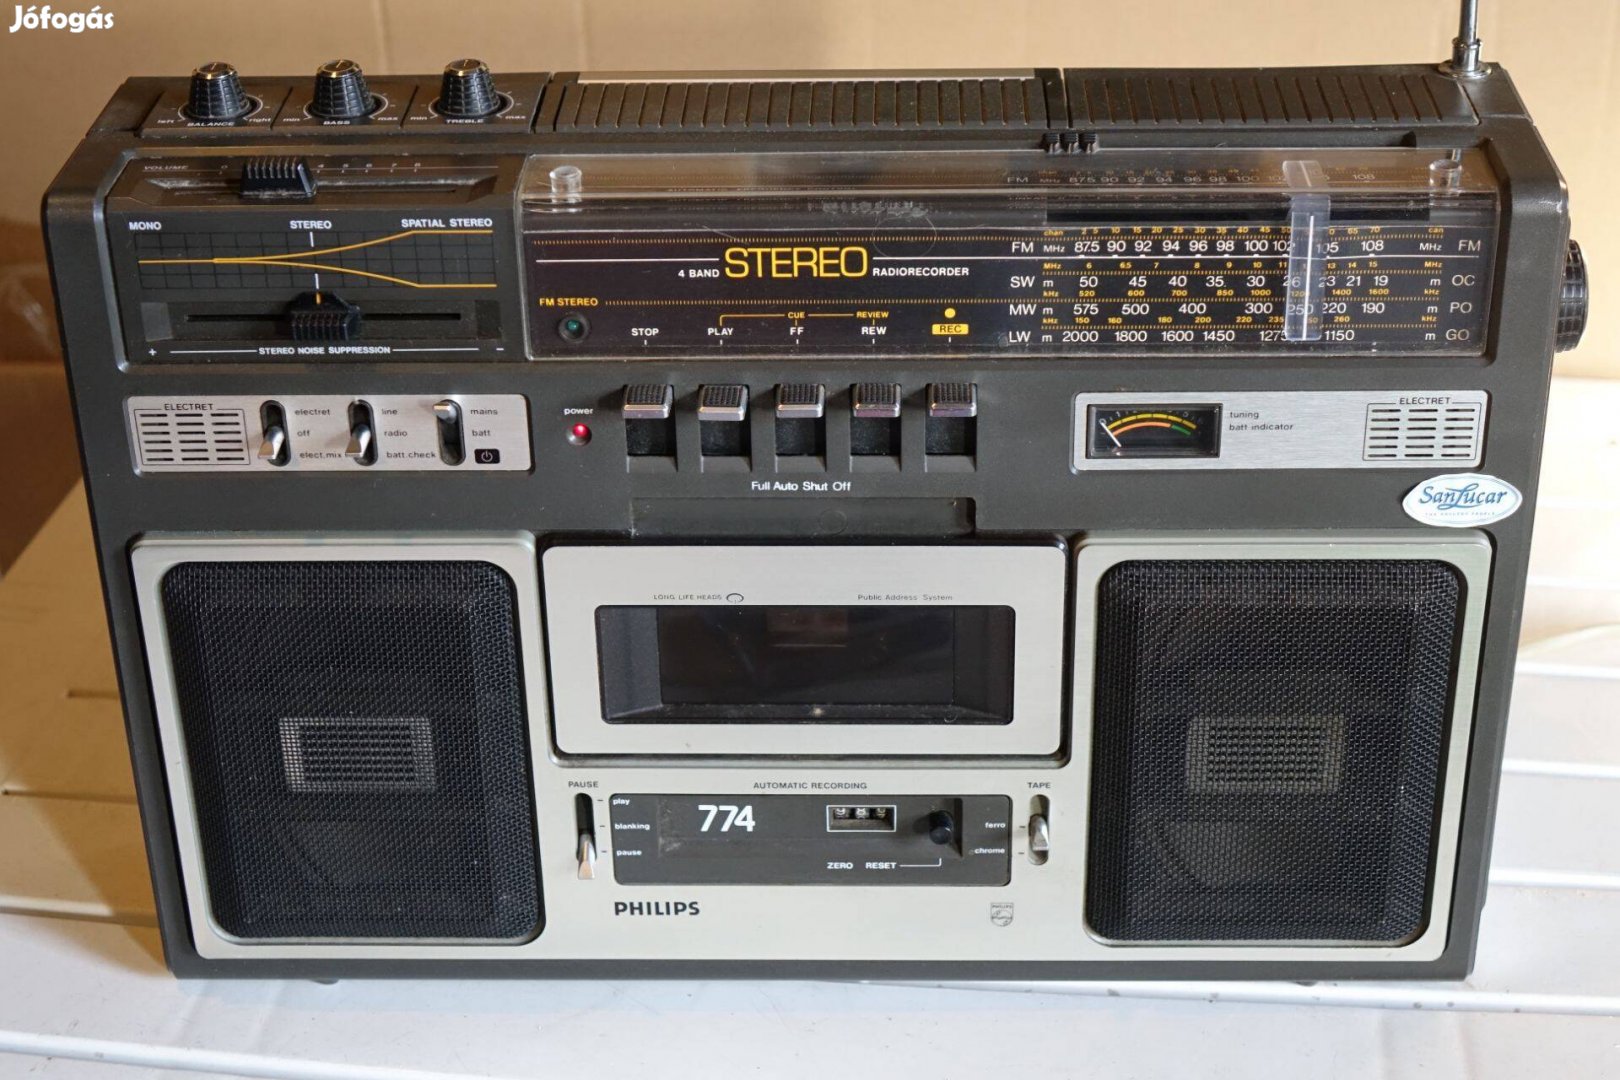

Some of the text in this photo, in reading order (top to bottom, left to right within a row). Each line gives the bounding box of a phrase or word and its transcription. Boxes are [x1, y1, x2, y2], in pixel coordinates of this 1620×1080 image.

[128, 221, 162, 230] MONO
[289, 220, 332, 229] STEREO
[401, 218, 493, 228] SPATIAL STEREO
[1012, 241, 1034, 253] FM
[1044, 245, 1065, 253] MHz
[1074, 240, 1100, 253] 87.5
[1107, 240, 1126, 252] 90
[1134, 240, 1152, 252] 92
[1162, 240, 1180, 252] 94
[1189, 240, 1208, 252] 96
[1216, 240, 1235, 252] 98
[1244, 240, 1268, 252] 100
[1361, 240, 1384, 252] 108
[1419, 243, 1442, 251] MHz
[1458, 240, 1481, 252] FM
[724, 246, 868, 278] STEREO
[1043, 262, 1062, 270] MHz
[677, 269, 720, 278] 4 BAND
[872, 267, 970, 277] RADIORECORDER
[1010, 276, 1035, 288] SW
[1043, 279, 1054, 288] m
[1079, 276, 1098, 288] 50
[1128, 276, 1147, 287] 45
[1168, 275, 1187, 288] 40
[1246, 275, 1265, 287] 30
[1283, 275, 1301, 288] 26
[1318, 275, 1336, 288] 23
[1346, 275, 1361, 287] 21
[1374, 275, 1389, 286] 19
[1430, 278, 1441, 286] m
[1452, 274, 1476, 287] OC
[1043, 290, 1059, 298] kHz
[539, 297, 599, 306] FM STEREO
[1009, 303, 1037, 316] MW
[1042, 306, 1054, 315] m
[1073, 303, 1099, 316] 575
[1121, 303, 1150, 315] 500
[1178, 302, 1207, 315] 400
[1244, 302, 1273, 314] 300
[1322, 302, 1347, 314] 220
[1361, 302, 1385, 314] 190
[1427, 305, 1438, 313] m
[1449, 302, 1472, 314] PO
[787, 311, 805, 319] CUE
[856, 311, 889, 319] REVIEW
[631, 328, 659, 336] STOP
[707, 328, 734, 336] PLAY
[790, 327, 804, 336] FF
[861, 327, 887, 335] REW
[939, 325, 962, 333] REC
[1009, 331, 1031, 343] LW
[1042, 334, 1052, 342] m
[1062, 331, 1099, 342] 2000
[1114, 331, 1148, 342] 1800
[1161, 330, 1194, 342] 1600
[1203, 330, 1235, 342] 1450
[1324, 329, 1355, 341] 1150
[1425, 332, 1436, 341] m
[1445, 329, 1470, 341] GO
[259, 346, 391, 355] STEREO NOISE SUPPRESSION
[1399, 397, 1451, 405] ELECTRET
[164, 403, 214, 411] ELECTRET
[564, 408, 594, 416] power
[1230, 411, 1259, 419] tuning
[1251, 423, 1294, 431] indicator
[472, 429, 491, 437] batt
[751, 481, 851, 491] Full Auto Shut Off
[1419, 483, 1507, 510] SanLucar
[613, 798, 630, 806] play
[698, 804, 756, 832] 774
[614, 823, 650, 831] blanking
[614, 901, 700, 916] PHILIPS
